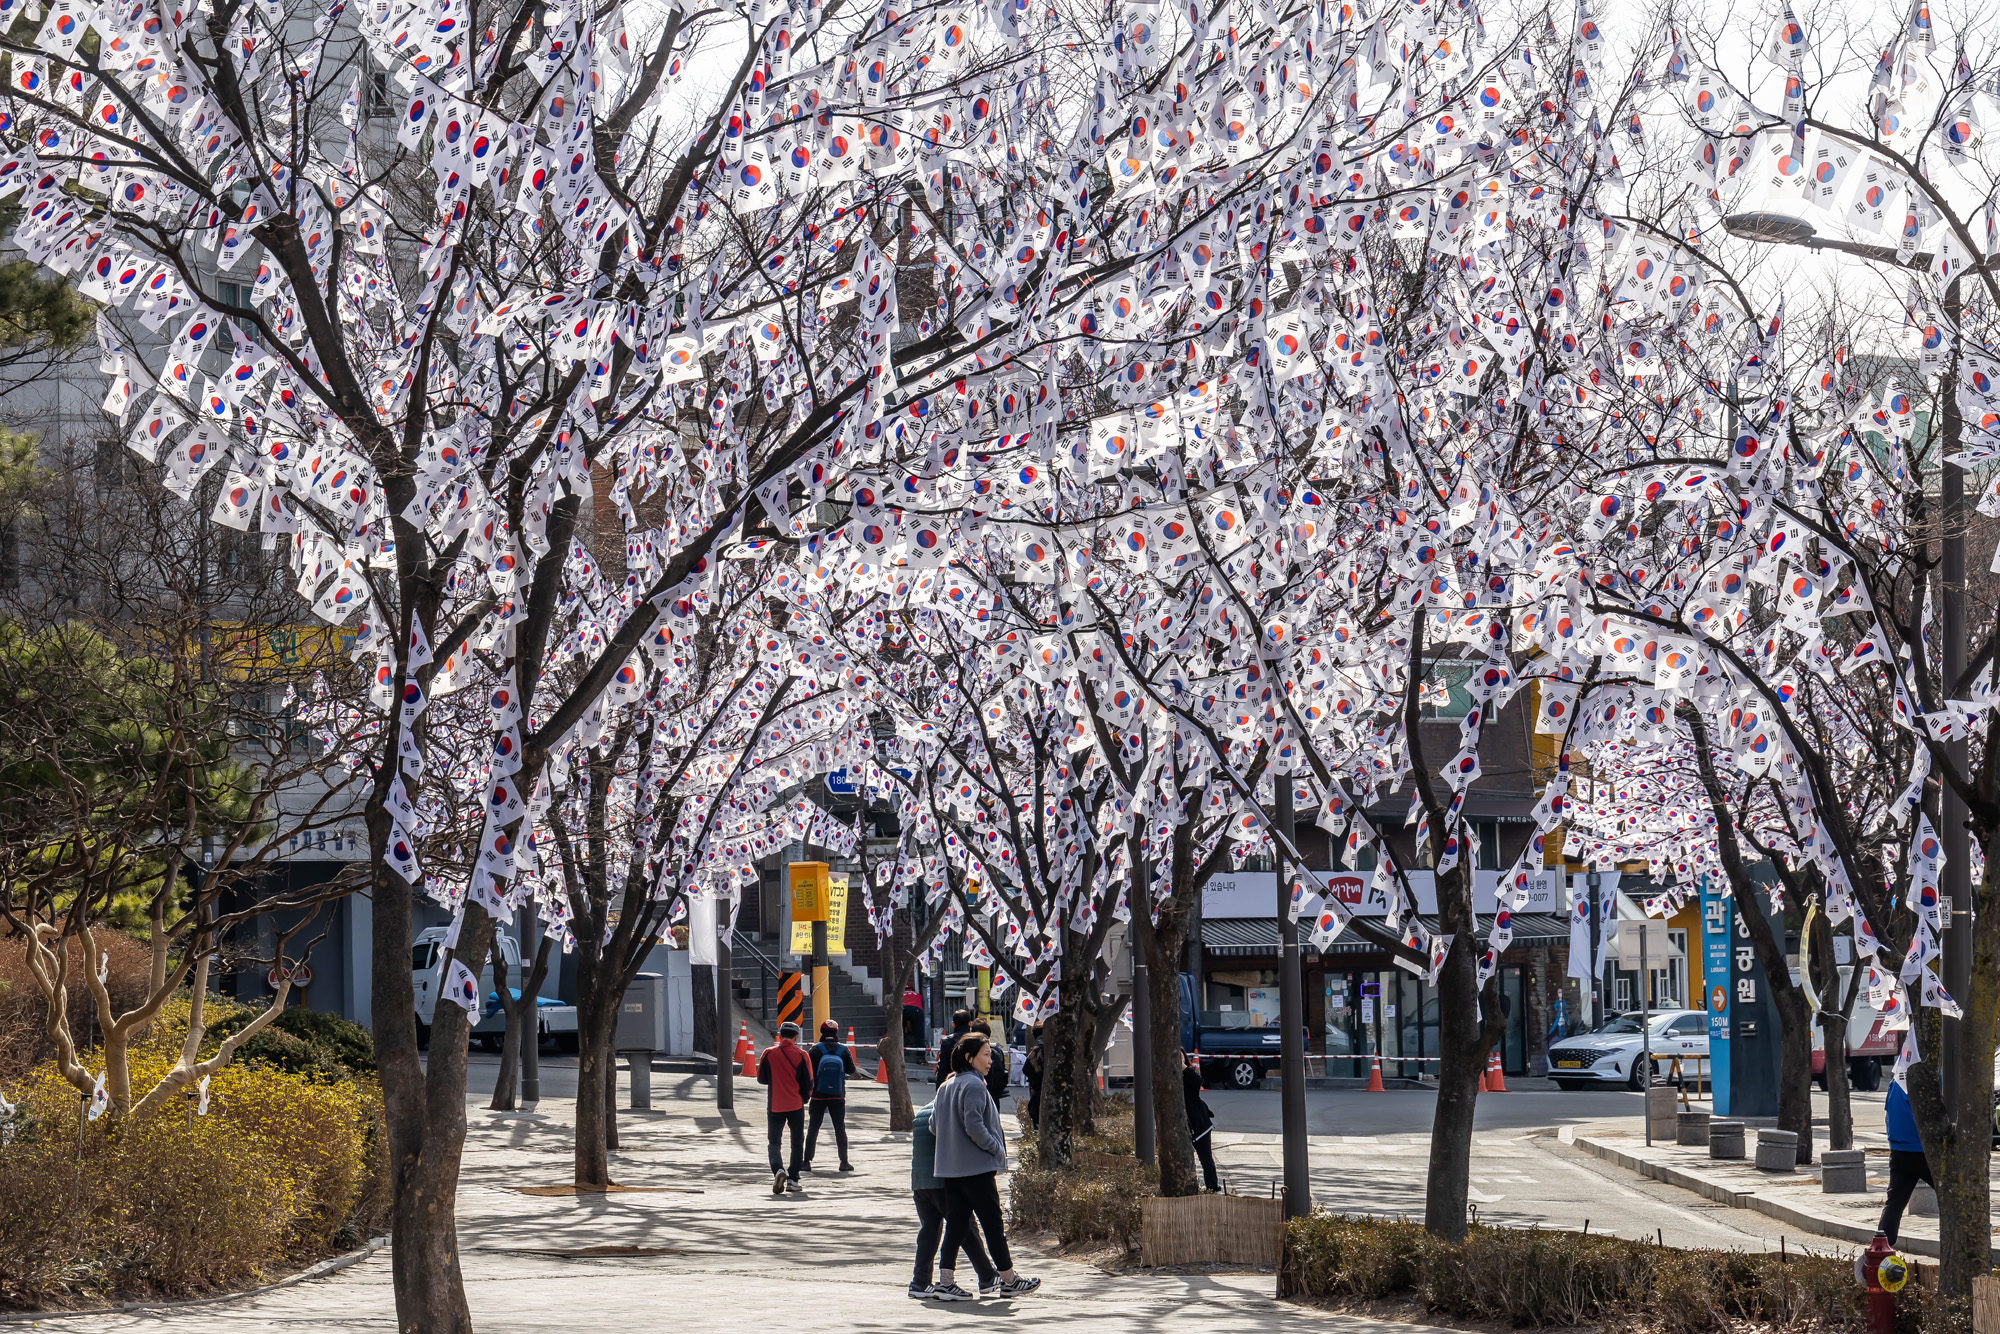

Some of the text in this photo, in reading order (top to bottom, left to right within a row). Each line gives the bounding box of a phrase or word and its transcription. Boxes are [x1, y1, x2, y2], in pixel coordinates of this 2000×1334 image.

[1209, 881, 1236, 892] 있습니다
[1331, 882, 1361, 899] 서가네
[1711, 1016, 1728, 1027] 150M
